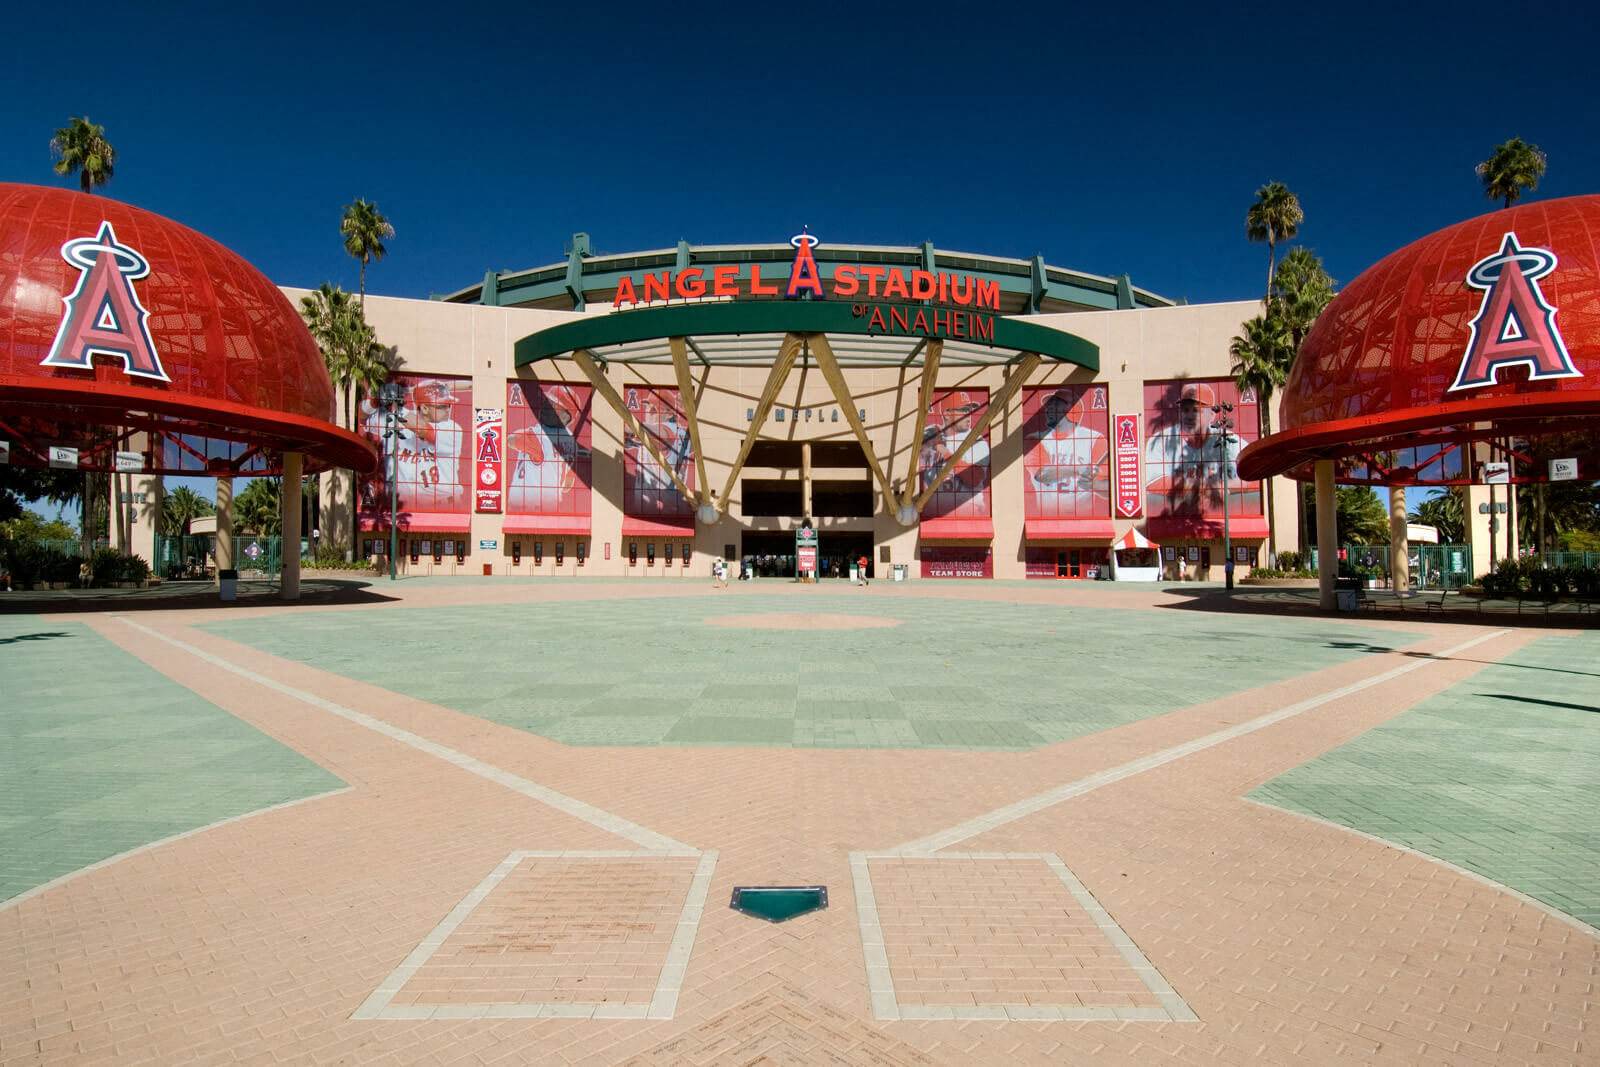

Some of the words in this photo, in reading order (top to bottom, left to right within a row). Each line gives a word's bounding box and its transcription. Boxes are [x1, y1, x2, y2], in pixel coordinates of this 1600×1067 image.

[612, 264, 779, 308] ANGEL
[784, 231, 827, 298] A
[833, 265, 1000, 310] STADIUM
[852, 304, 868, 318] OF
[868, 306, 994, 341] ANAHEIM
